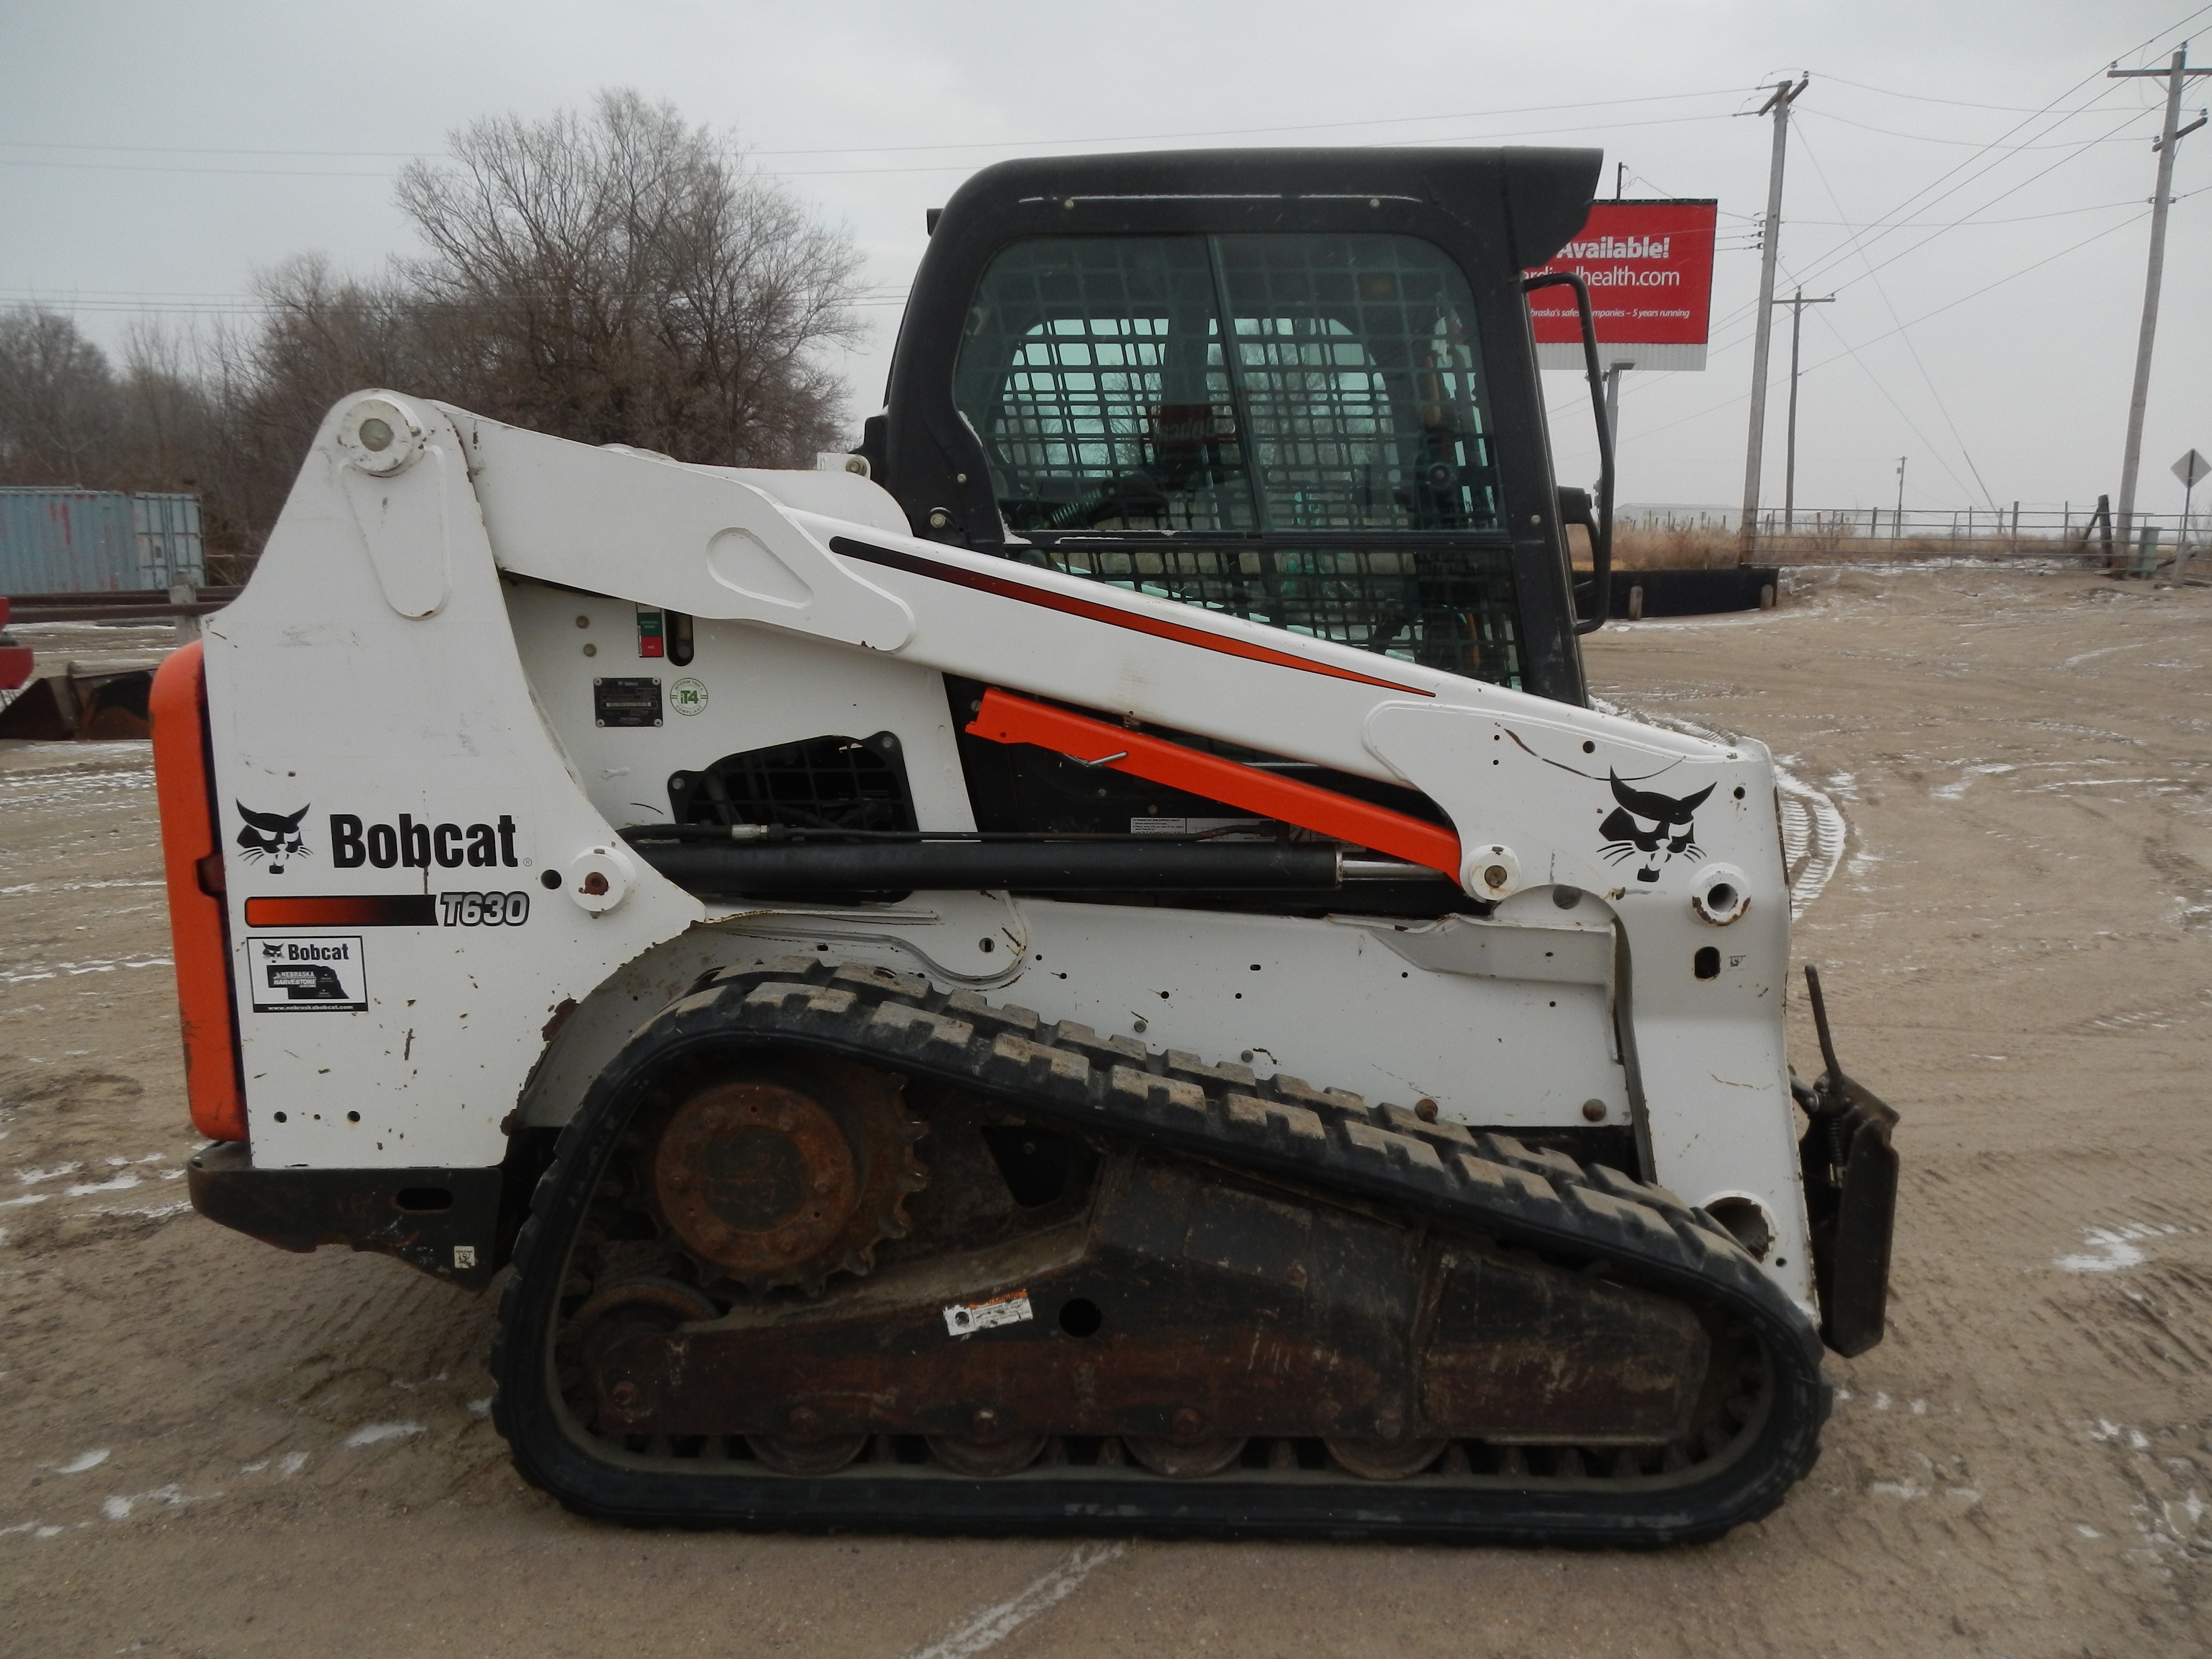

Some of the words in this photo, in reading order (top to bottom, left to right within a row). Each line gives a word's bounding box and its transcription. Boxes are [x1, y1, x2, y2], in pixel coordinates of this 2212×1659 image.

[1557, 236, 1670, 259] Available!
[1531, 308, 1560, 317] braska's
[1562, 308, 1580, 317] safes
[1591, 308, 1624, 319] mpanies
[1632, 309, 1638, 317] 5
[1637, 310, 1658, 319] years
[1659, 308, 1690, 319] running
[676, 705, 703, 714] COMPLIANT
[330, 813, 518, 868] Bobcat
[440, 891, 529, 926] T630
[289, 943, 349, 961] Bobcat
